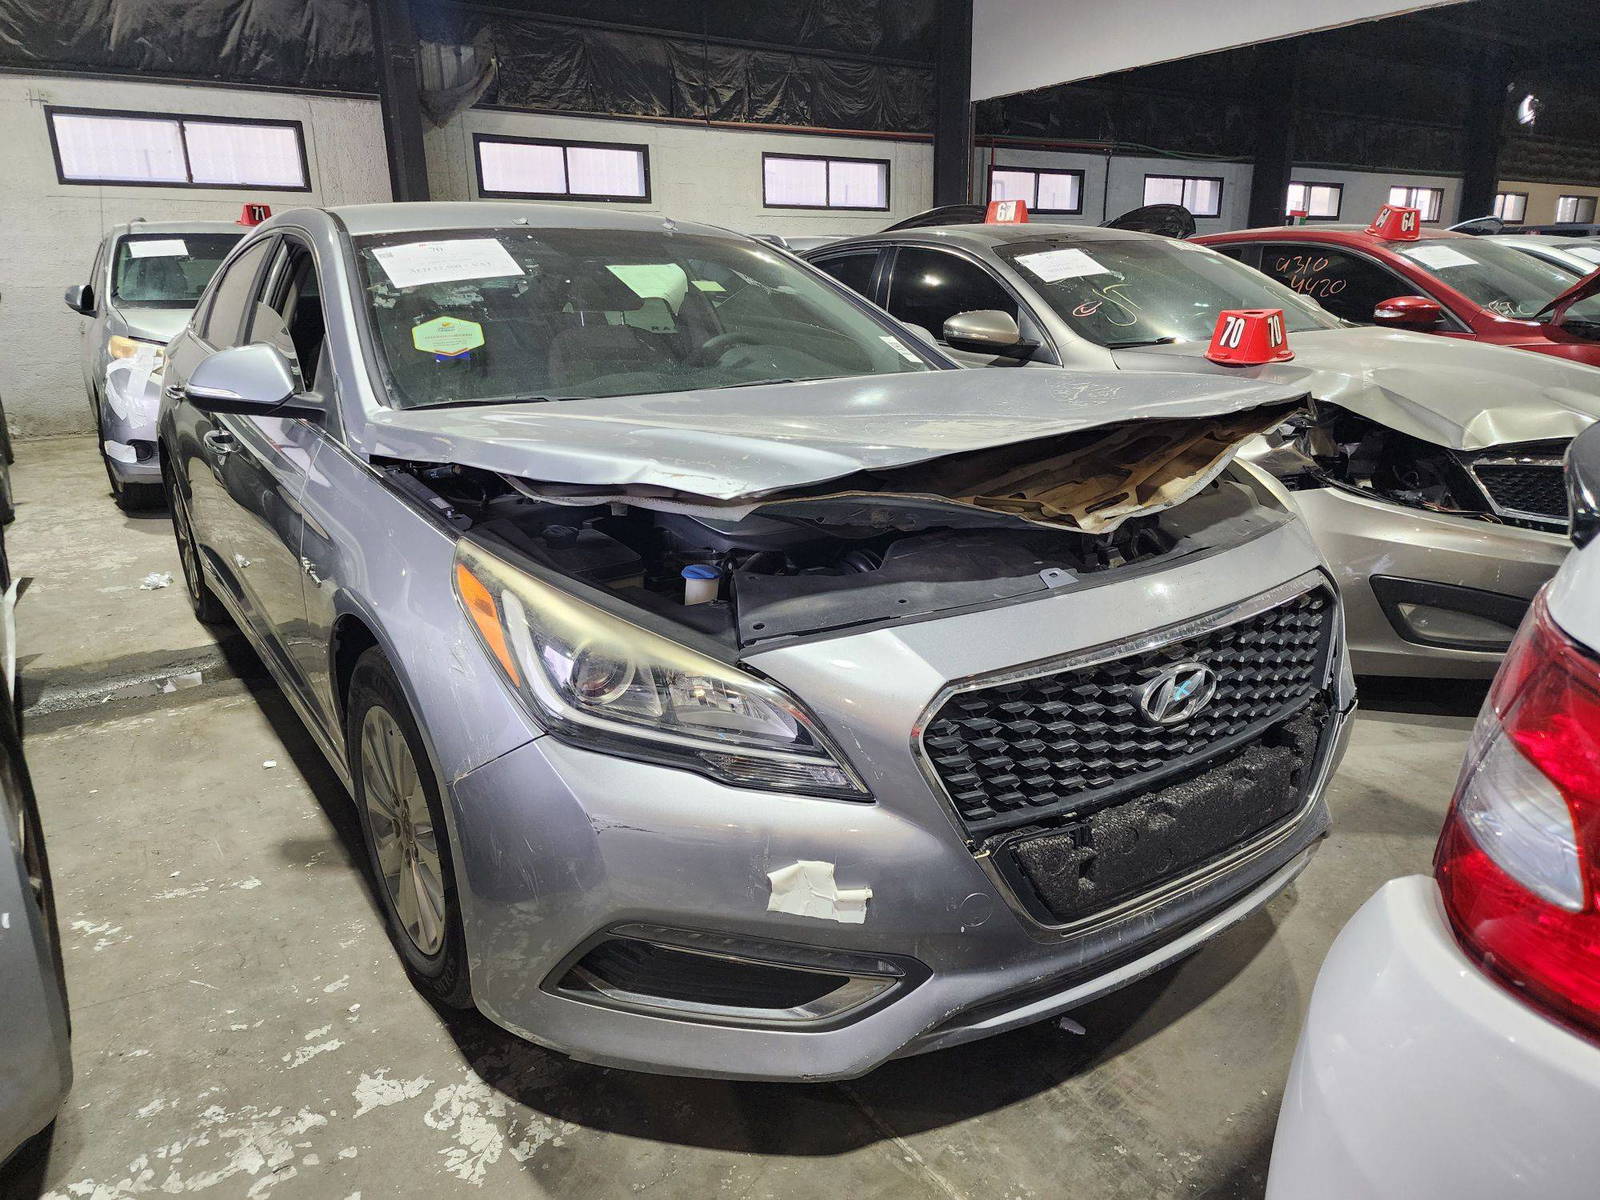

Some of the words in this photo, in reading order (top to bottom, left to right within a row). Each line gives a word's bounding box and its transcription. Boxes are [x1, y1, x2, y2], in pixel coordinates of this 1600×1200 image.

[252, 206, 266, 221] 71
[1401, 212, 1416, 232] 64
[1219, 316, 1246, 349] 70
[1267, 315, 1283, 348] 70
